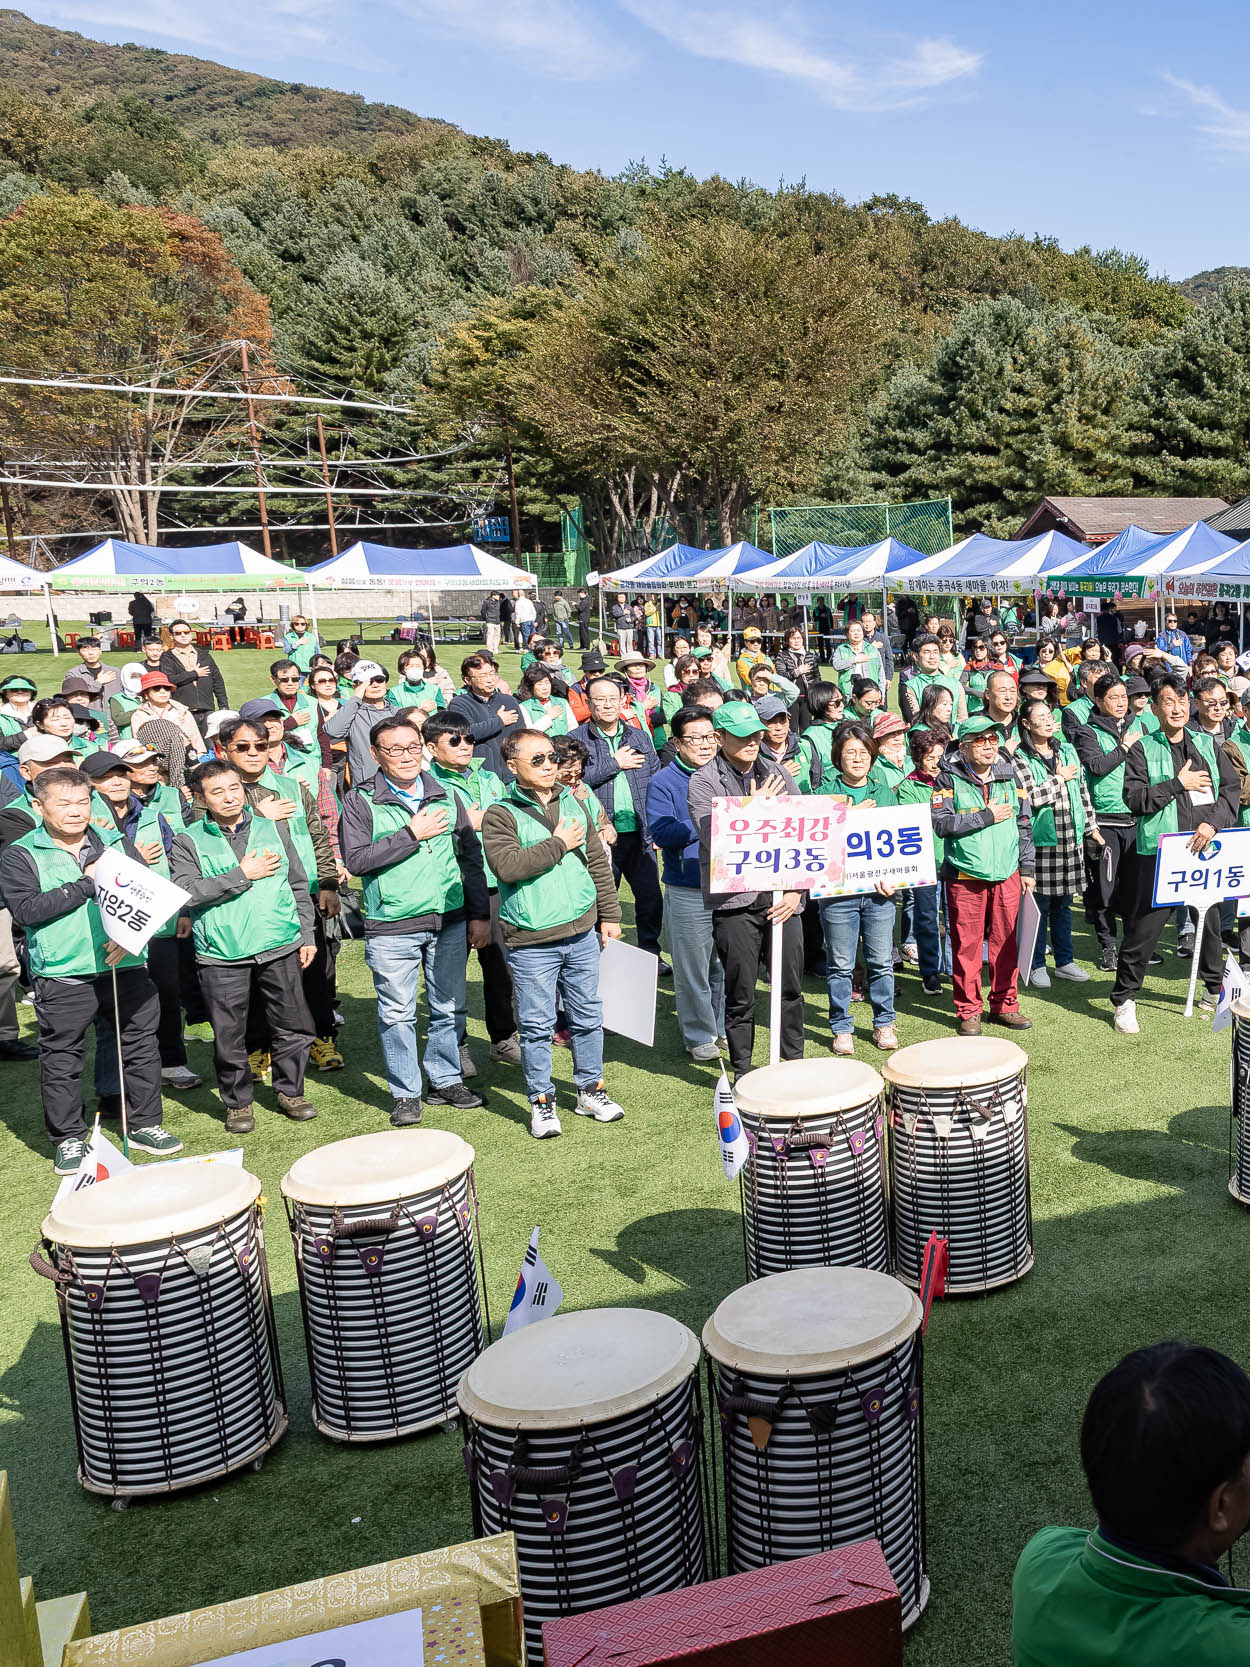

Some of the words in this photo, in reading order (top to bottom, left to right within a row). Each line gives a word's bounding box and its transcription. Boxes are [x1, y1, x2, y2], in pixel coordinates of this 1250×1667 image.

[909, 579, 935, 592] 함께하는
[937, 580, 963, 592] 중곡4동
[991, 580, 1009, 592] 아자!
[1178, 581, 1195, 596] 오늘의
[726, 815, 832, 844] 우주최강
[726, 847, 828, 875] 구의3동
[1167, 865, 1245, 893] 구의1동
[97, 885, 152, 932] 자양2동
